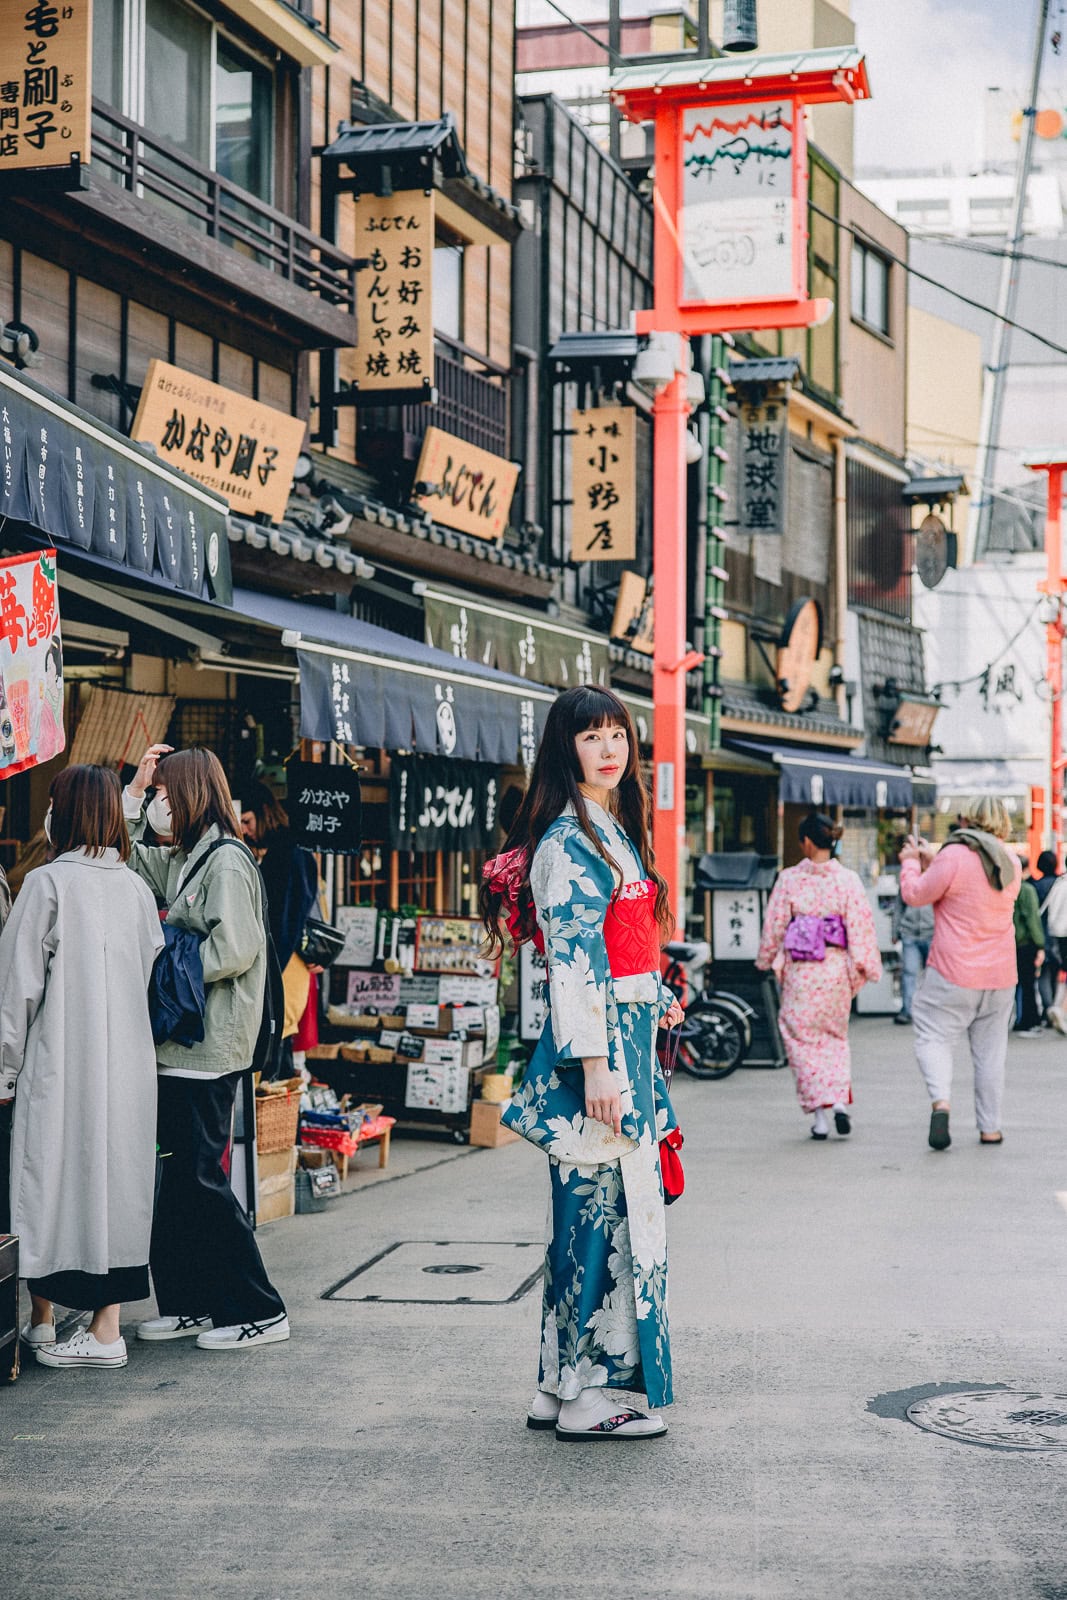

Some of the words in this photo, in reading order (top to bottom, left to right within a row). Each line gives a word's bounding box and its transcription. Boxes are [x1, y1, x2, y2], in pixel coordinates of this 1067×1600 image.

[61, 6, 74, 19] け
[24, 0, 59, 150] 毛と刷子
[60, 74, 74, 140] ぶらし
[364, 215, 421, 232] ふじでん
[366, 248, 392, 377] もんじゃ焼
[397, 246, 423, 376] お好み焼
[160, 407, 280, 487] かなや刷子
[744, 427, 779, 528] 地球堂
[298, 787, 350, 810] かなや
[305, 812, 343, 834] 刷子
